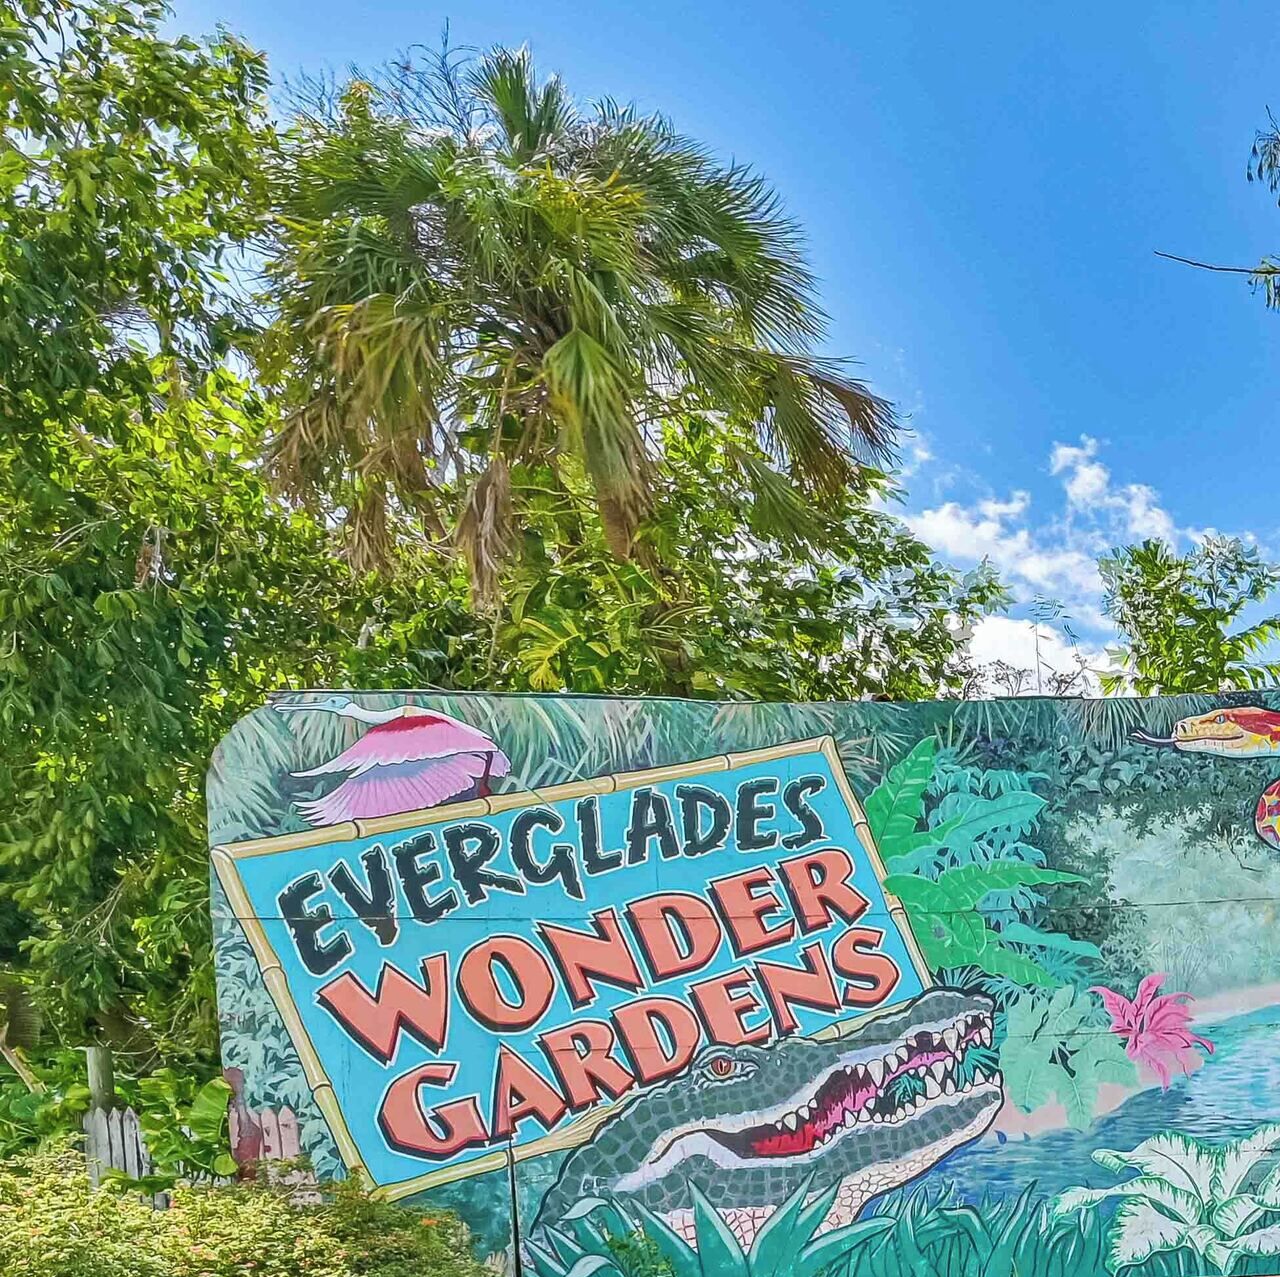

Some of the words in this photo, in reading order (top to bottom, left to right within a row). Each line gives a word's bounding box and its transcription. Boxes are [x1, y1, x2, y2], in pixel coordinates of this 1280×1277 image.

[278, 775, 828, 975] EVERGLADES
[317, 848, 869, 1064] WONDER
[378, 928, 900, 1160] GARDENS
